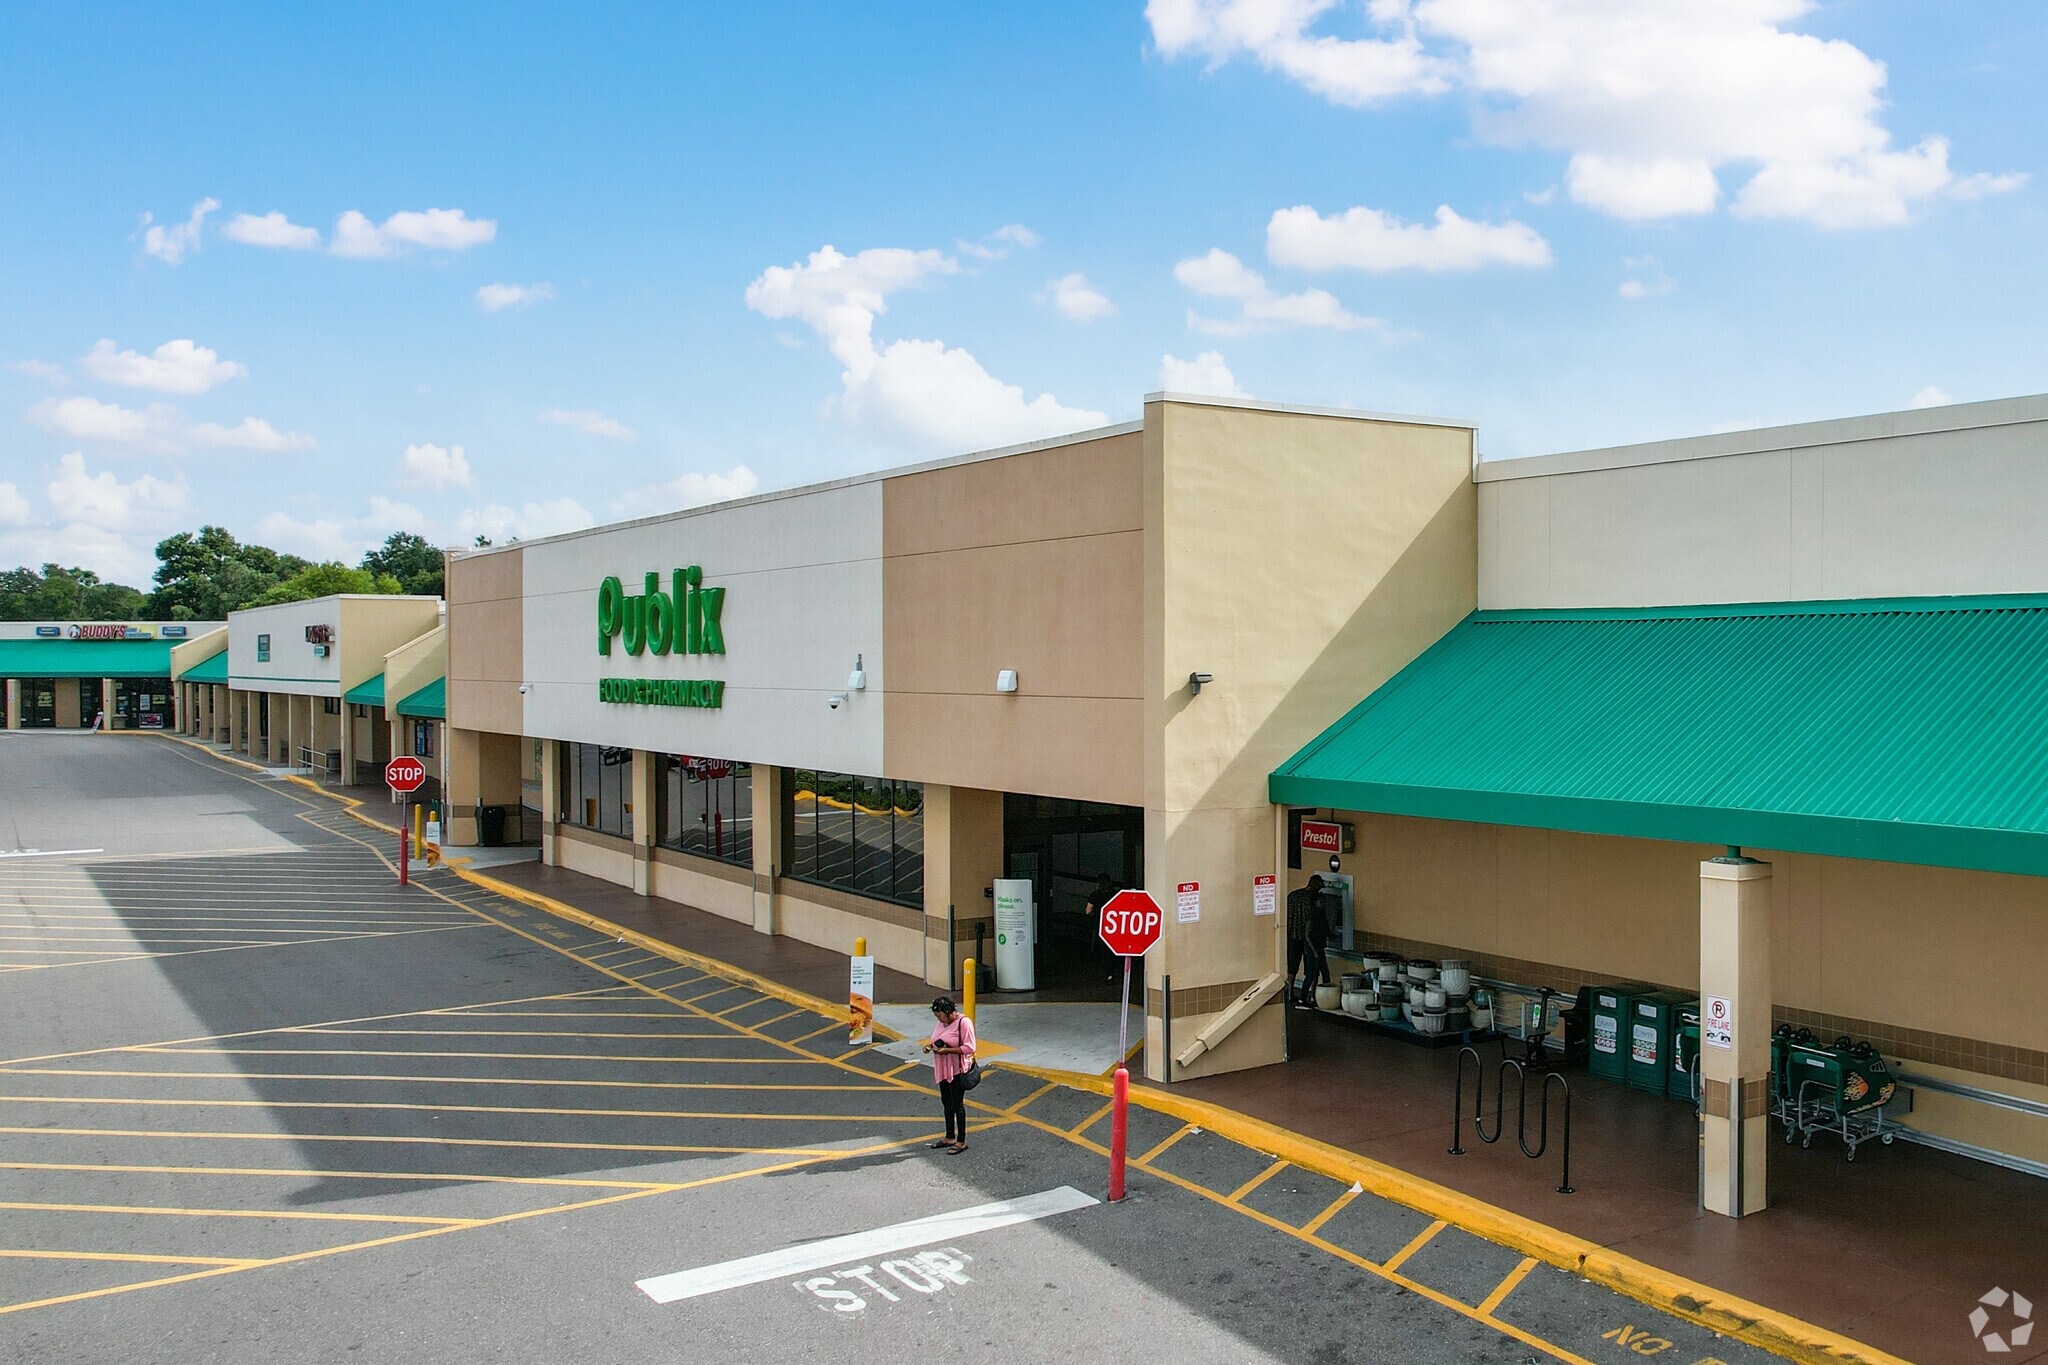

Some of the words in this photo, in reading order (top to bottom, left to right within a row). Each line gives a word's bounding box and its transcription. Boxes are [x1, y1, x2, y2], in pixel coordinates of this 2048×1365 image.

[598, 565, 726, 656] Publix
[81, 625, 126, 638] BUDDY'S
[600, 678, 634, 703] FOOD
[634, 679, 646, 704] &
[646, 679, 725, 708] PHARMACY
[389, 767, 423, 781] STOP
[1304, 829, 1337, 845] Presto!
[1104, 910, 1159, 935] STOP
[1707, 1018, 1717, 1028] FIRE
[1718, 1020, 1730, 1031] LANE
[800, 1248, 972, 1312] STOP
[1600, 1325, 1673, 1356] NO
